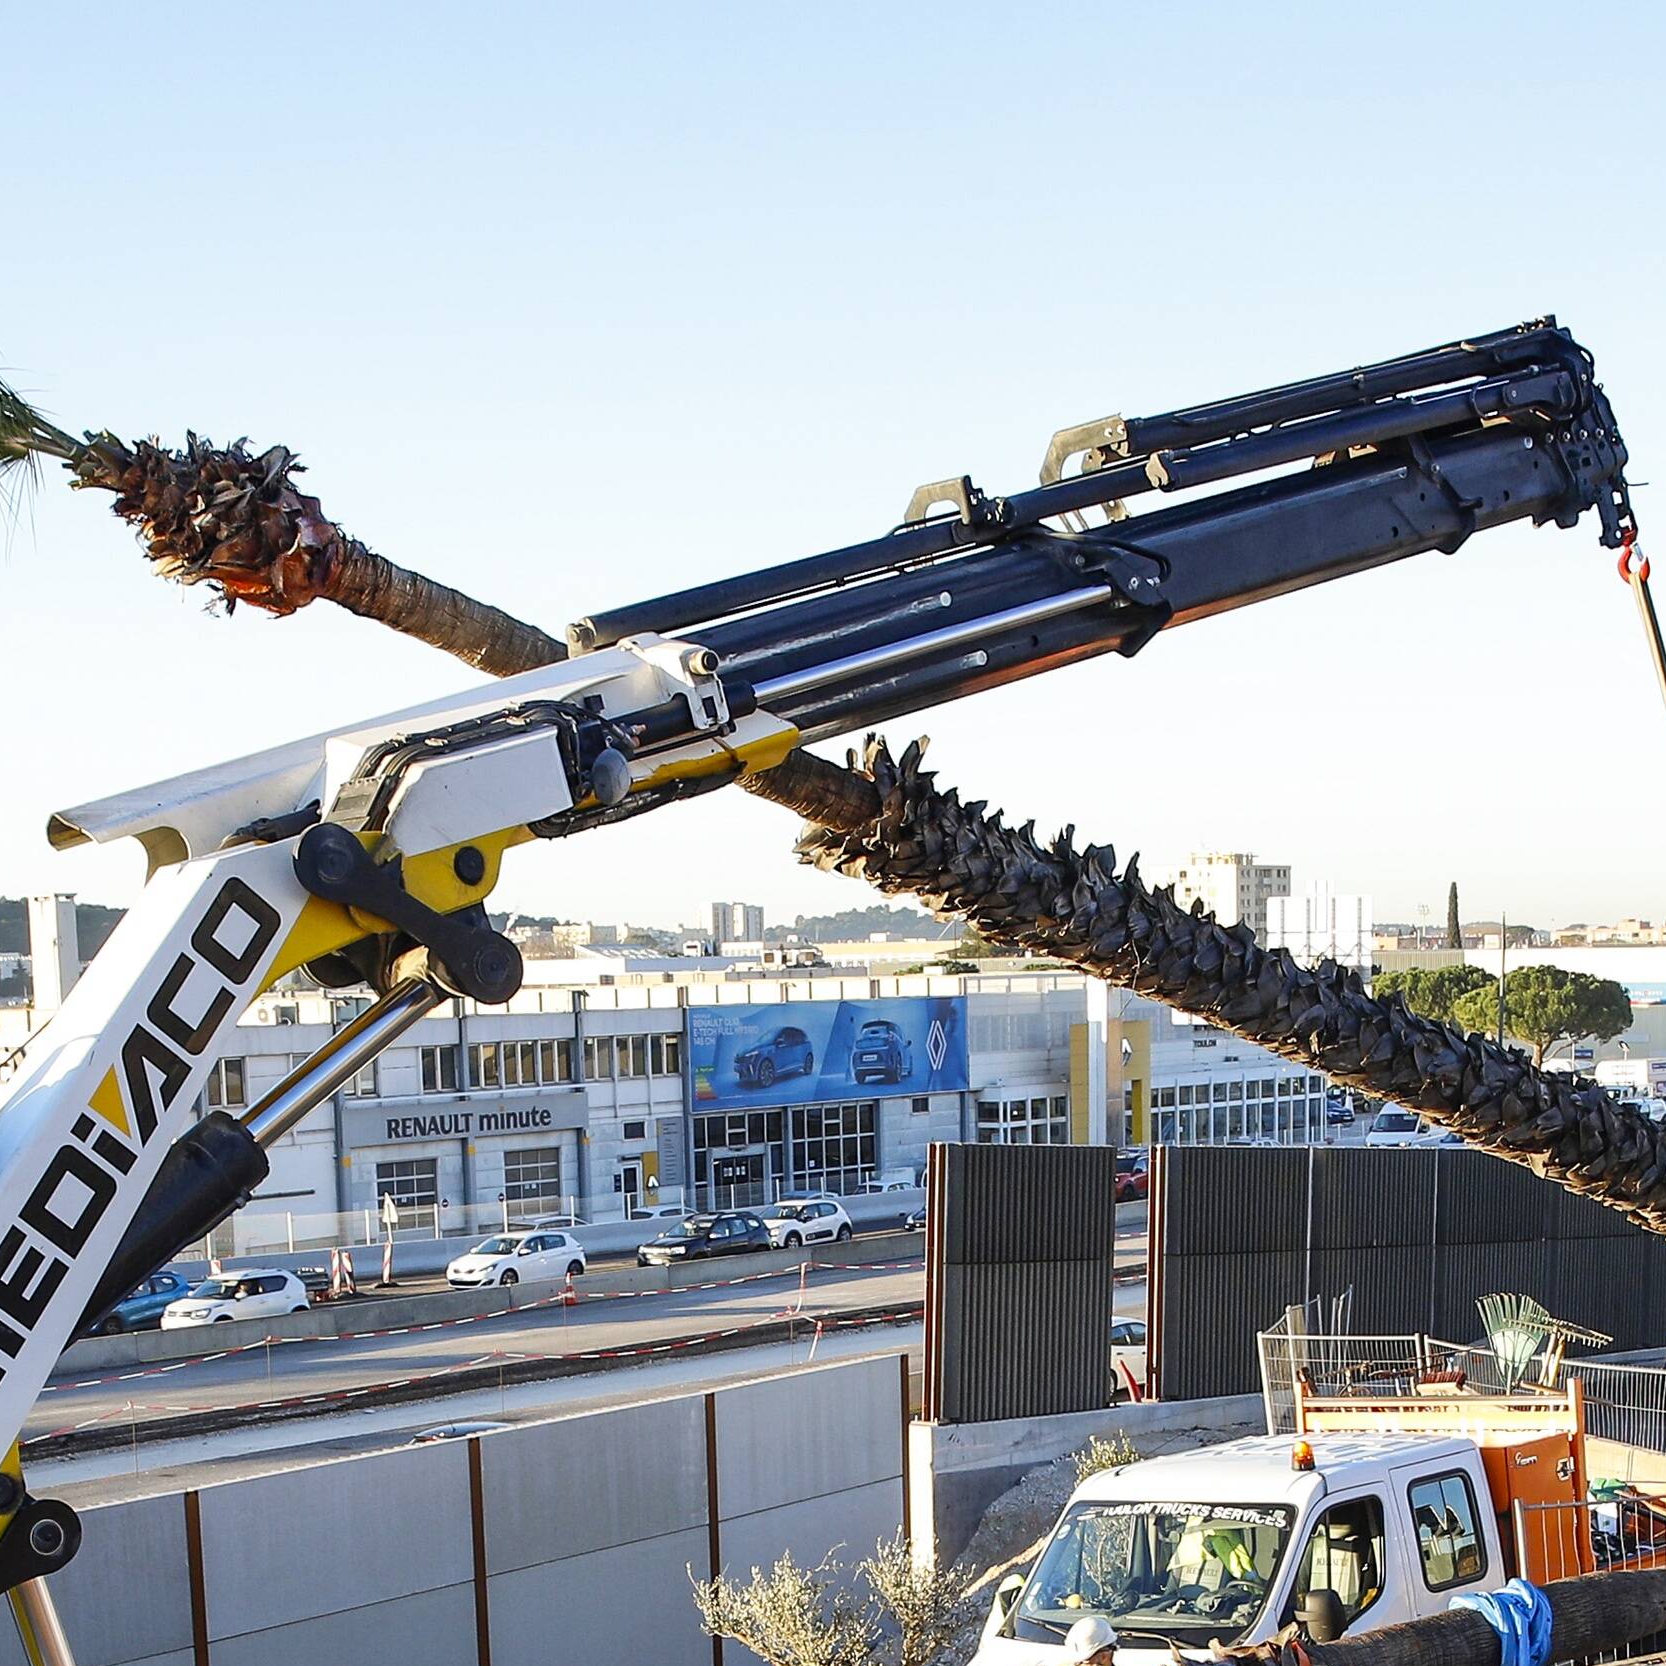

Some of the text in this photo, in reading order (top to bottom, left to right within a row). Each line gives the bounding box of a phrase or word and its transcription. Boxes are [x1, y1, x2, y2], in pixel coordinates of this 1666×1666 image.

[386, 1104, 551, 1139] RENAULT minute
[1154, 1503, 1211, 1518] TRUCKS
[1211, 1507, 1287, 1528] SERVICES
